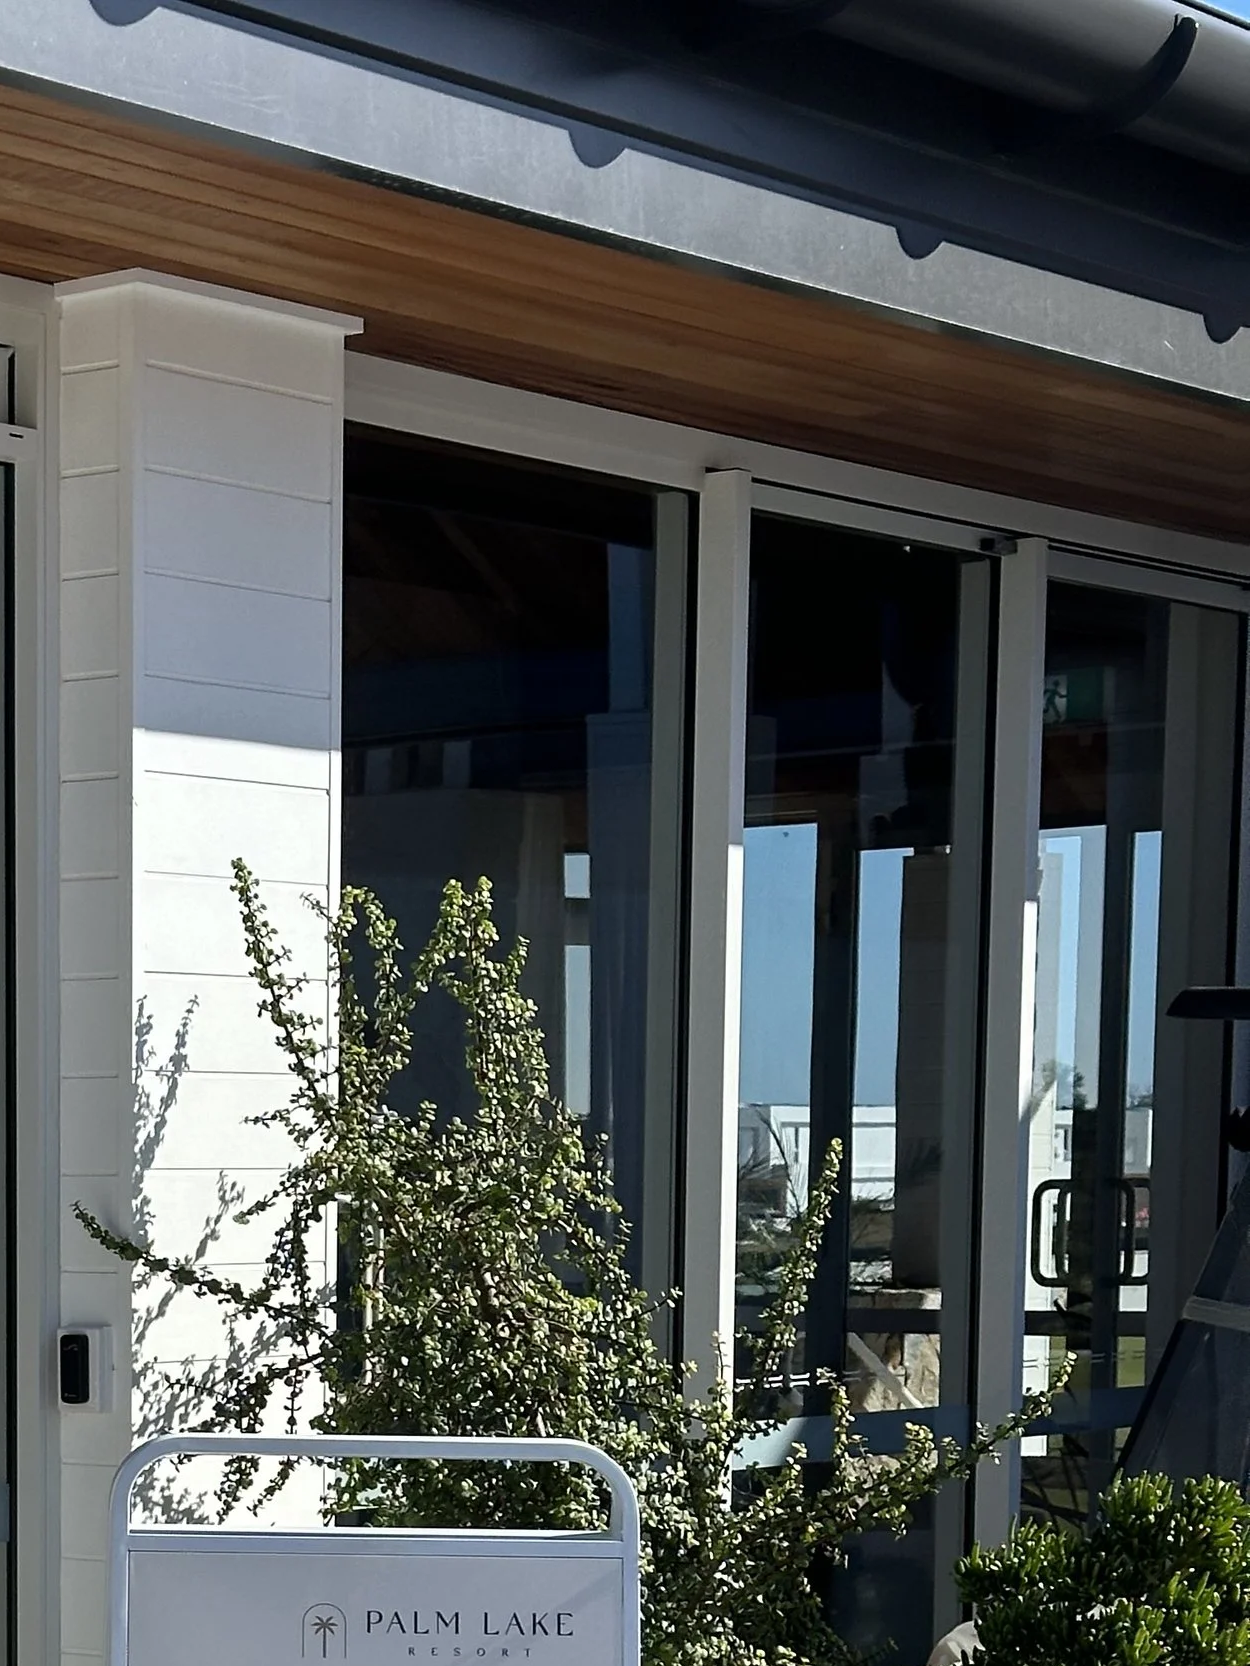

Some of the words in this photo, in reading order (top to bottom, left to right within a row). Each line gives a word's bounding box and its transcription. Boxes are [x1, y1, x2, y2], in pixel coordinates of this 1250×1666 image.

[366, 1610, 460, 1635] PALM
[483, 1611, 574, 1636] LAKE
[408, 1647, 531, 1657] RESORT
